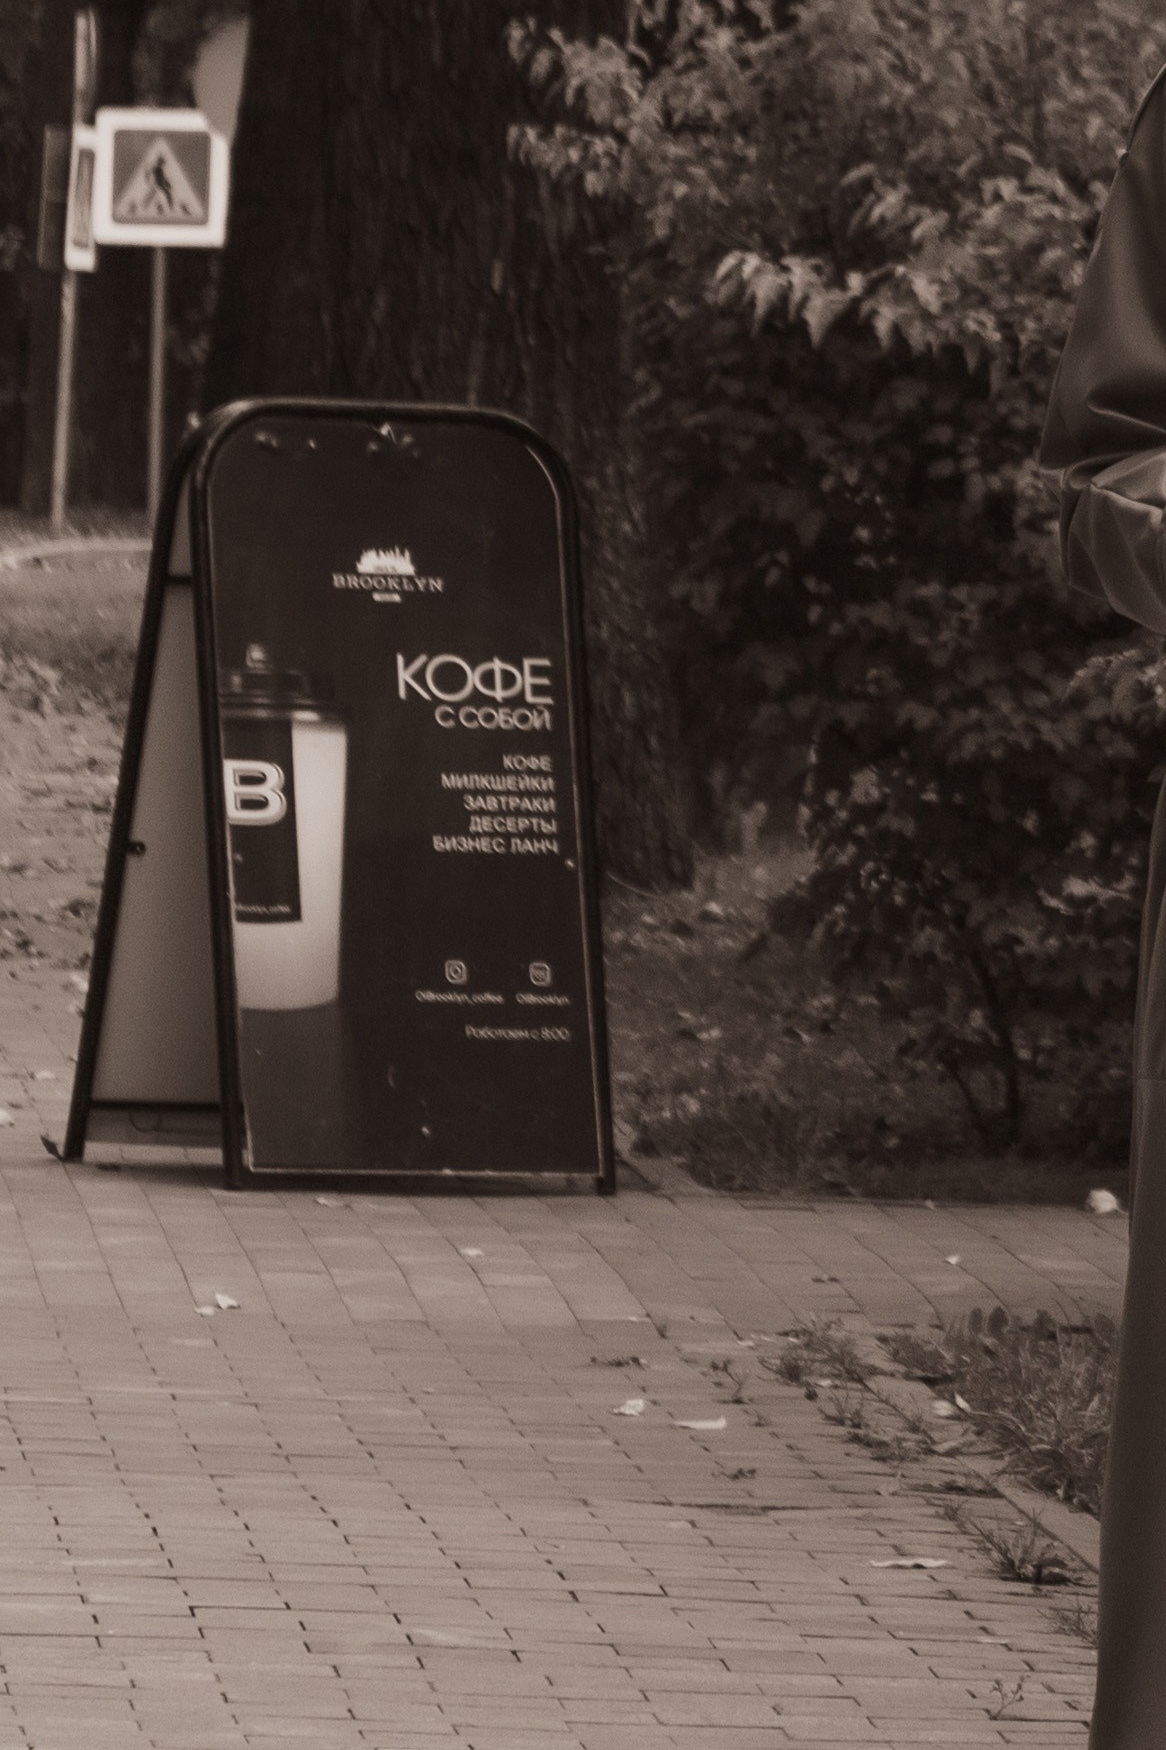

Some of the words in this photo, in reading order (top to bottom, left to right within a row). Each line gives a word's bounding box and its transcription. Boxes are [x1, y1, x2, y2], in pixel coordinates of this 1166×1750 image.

[332, 573, 444, 592] BROOKLYN
[396, 652, 554, 704] КОФЕ
[434, 705, 456, 729] С
[458, 705, 553, 731] СОБОЙ
[502, 753, 552, 772] КОФЕ
[441, 772, 556, 792] МИЛКШЕЙКИ
[222, 758, 288, 827] B
[462, 793, 557, 813] ЗАВТРАКИ
[468, 815, 559, 835] ДЕСЕРТЫ
[432, 834, 506, 854] БИЗНЕС
